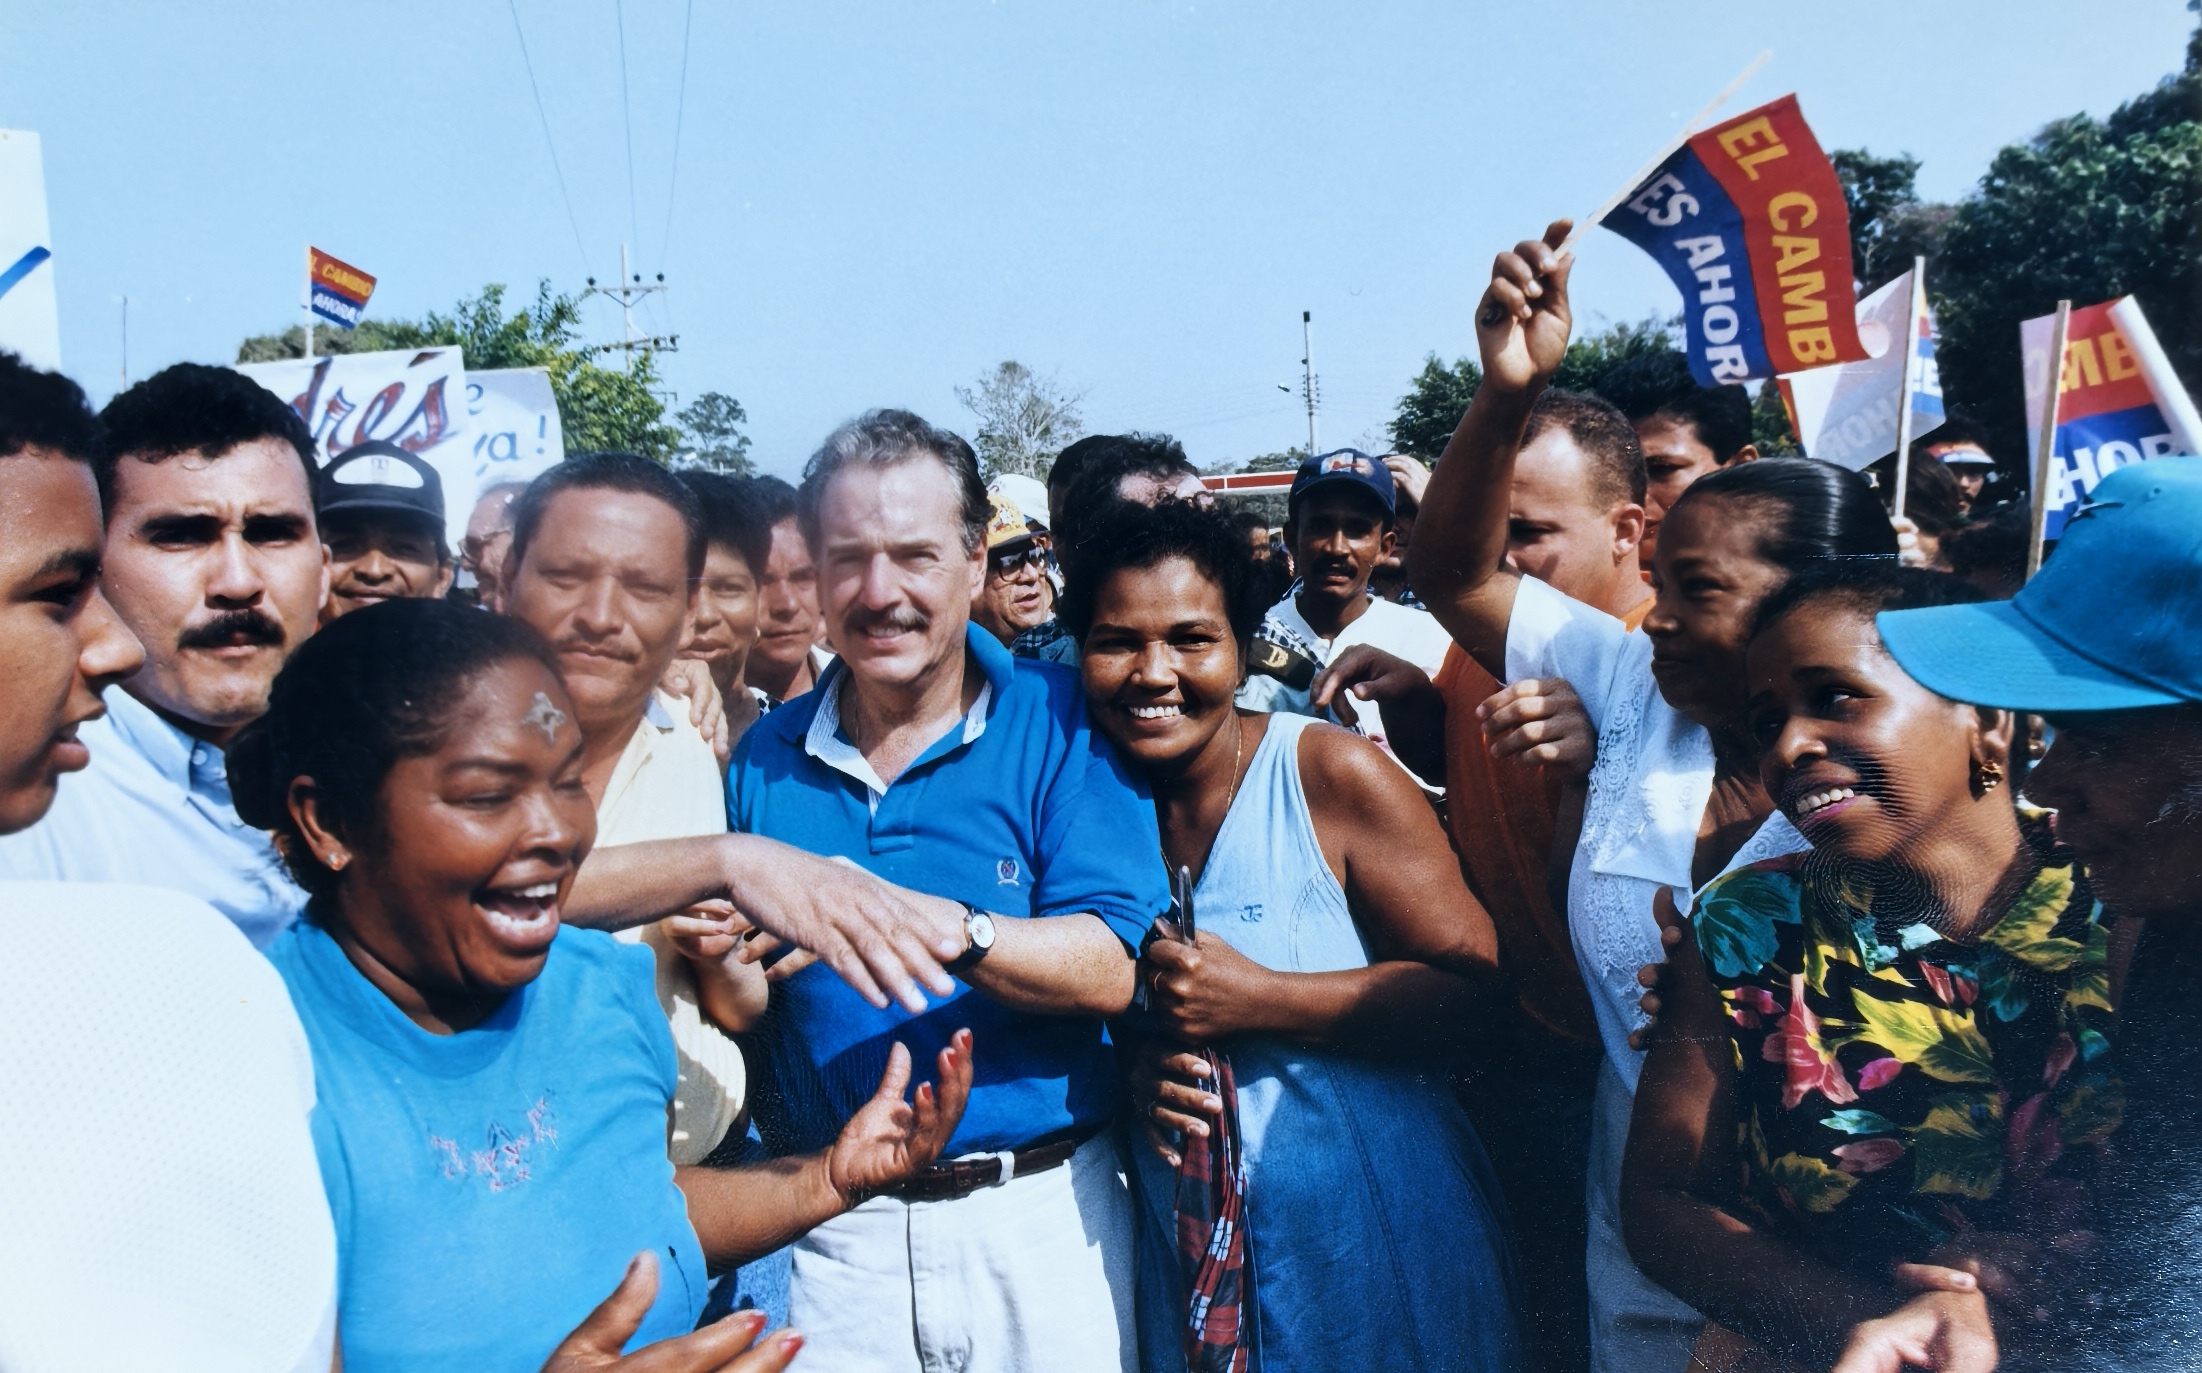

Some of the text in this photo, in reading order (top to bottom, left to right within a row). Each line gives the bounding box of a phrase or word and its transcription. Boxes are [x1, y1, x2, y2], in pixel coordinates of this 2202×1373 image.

[1674, 234, 1750, 386] AHOR
[1717, 115, 1837, 364] EL CAMB
